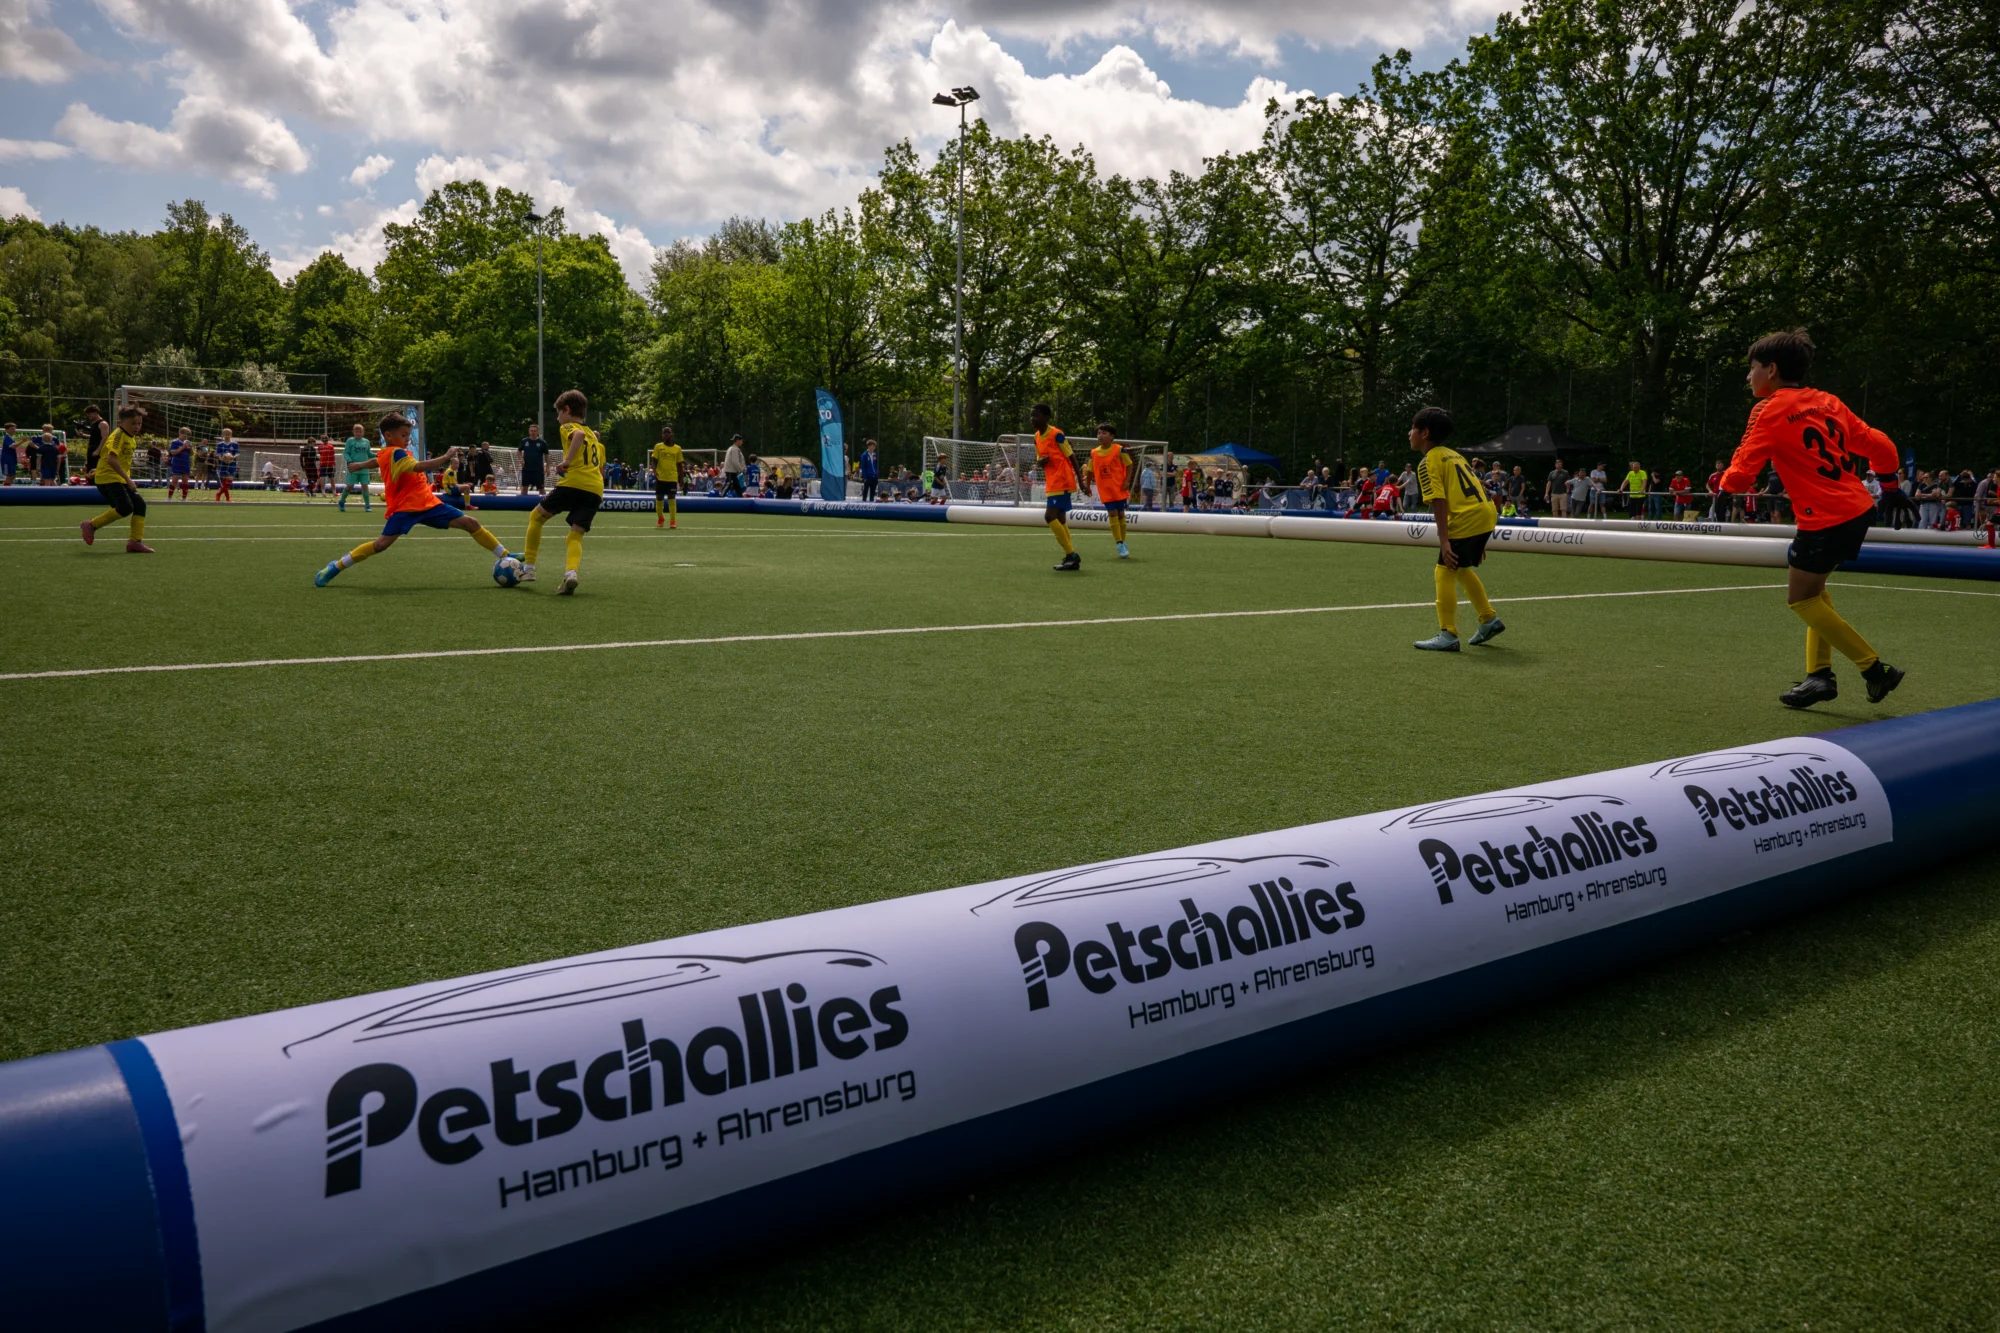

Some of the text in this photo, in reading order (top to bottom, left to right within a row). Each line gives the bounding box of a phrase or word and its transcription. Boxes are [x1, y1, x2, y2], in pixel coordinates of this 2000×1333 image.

[1787, 406, 1828, 424] Meiendo
[583, 440, 599, 467] 18
[751, 473, 759, 483] 21
[599, 500, 655, 511] kswagen
[1069, 510, 1138, 524] Volkswen
[1656, 522, 1722, 534] Volkswagen
[1684, 766, 1857, 837] Petschallies
[1754, 830, 1803, 854] Hamburg
[1809, 813, 1866, 838] Ahrensburg
[1419, 811, 1657, 905] Petschallies
[1505, 892, 1575, 923] Hamburg
[1586, 867, 1667, 901] Ahrensburg
[1014, 877, 1365, 1011] Petschallies
[1128, 983, 1235, 1028] Hamburg
[1254, 945, 1374, 993] Ahrensburg
[325, 983, 909, 1198] Petschallies
[499, 1135, 683, 1208] Hamburg
[717, 1070, 916, 1146] Ahrensburg
